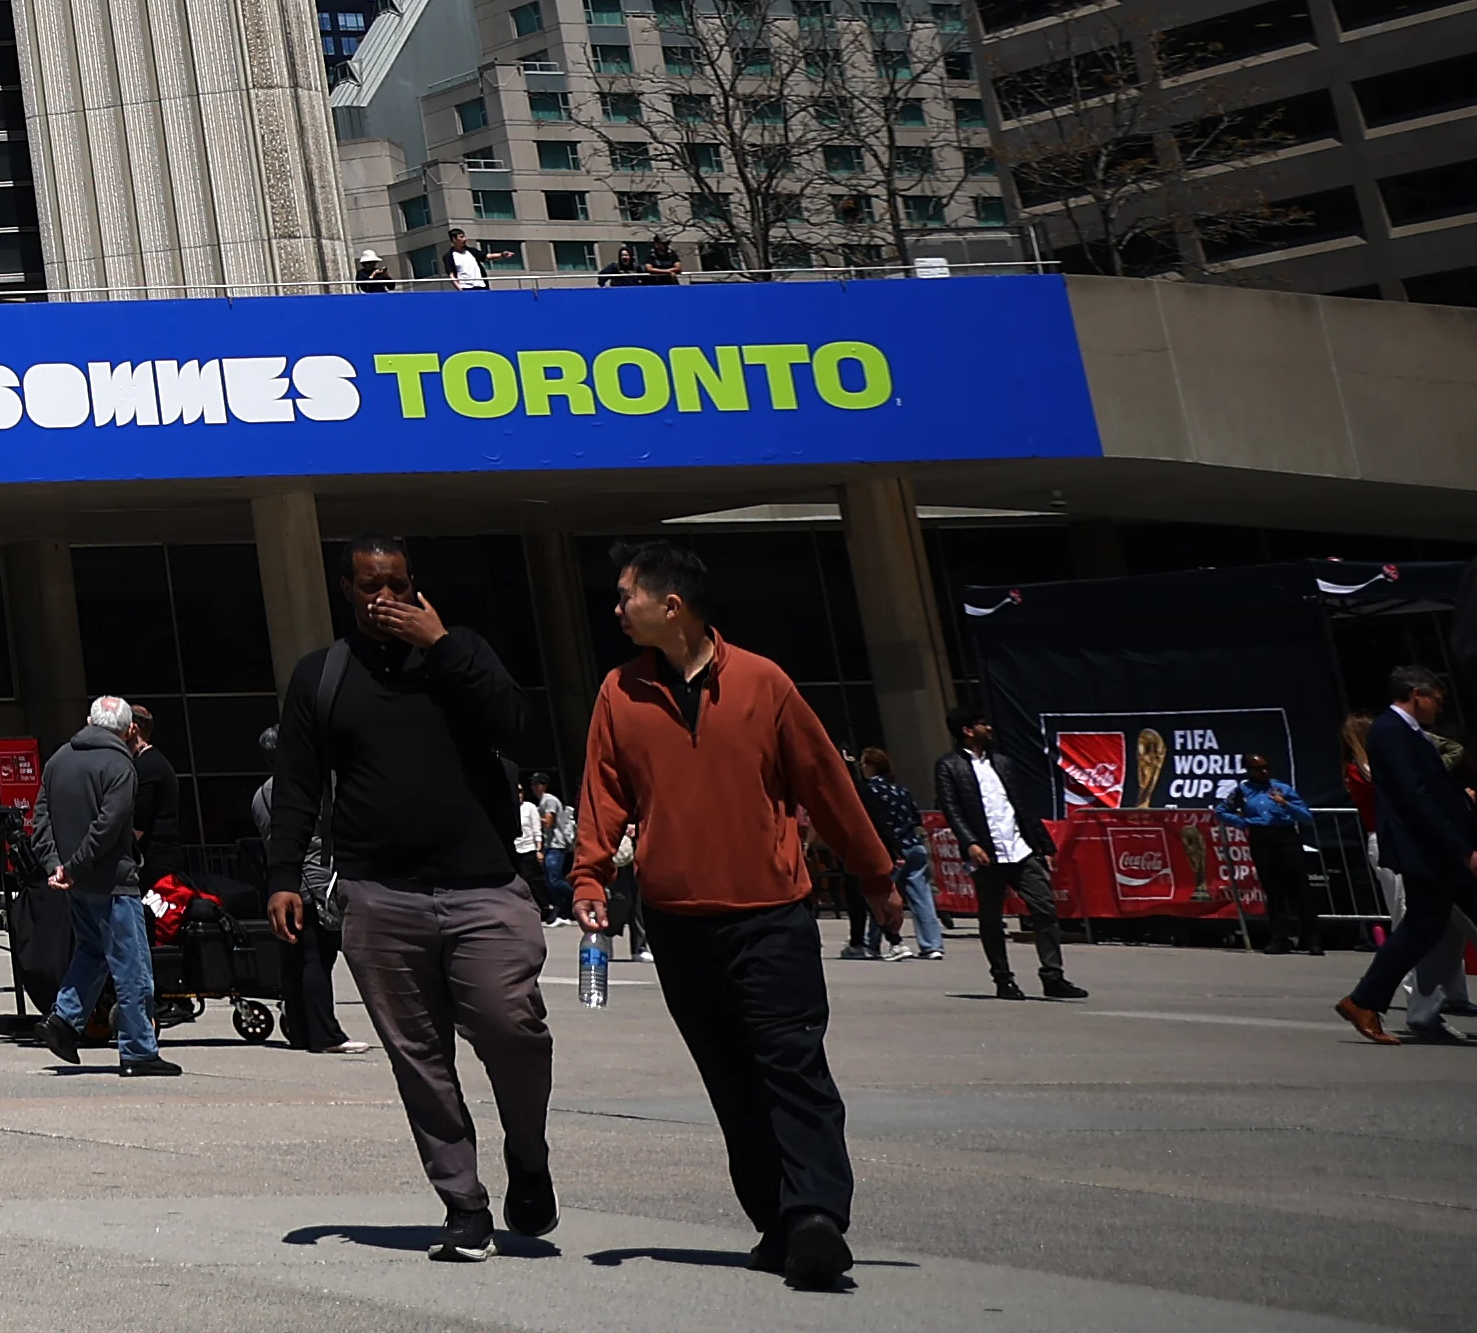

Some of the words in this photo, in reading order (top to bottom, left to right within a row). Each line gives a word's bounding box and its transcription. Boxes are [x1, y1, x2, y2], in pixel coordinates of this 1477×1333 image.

[374, 341, 892, 419] TORONTO
[1173, 729, 1219, 750] FIFA
[1173, 754, 1248, 775] WORL
[1169, 779, 1214, 798] CUP
[1210, 826, 1247, 842] FFA
[1213, 846, 1253, 861] WOR
